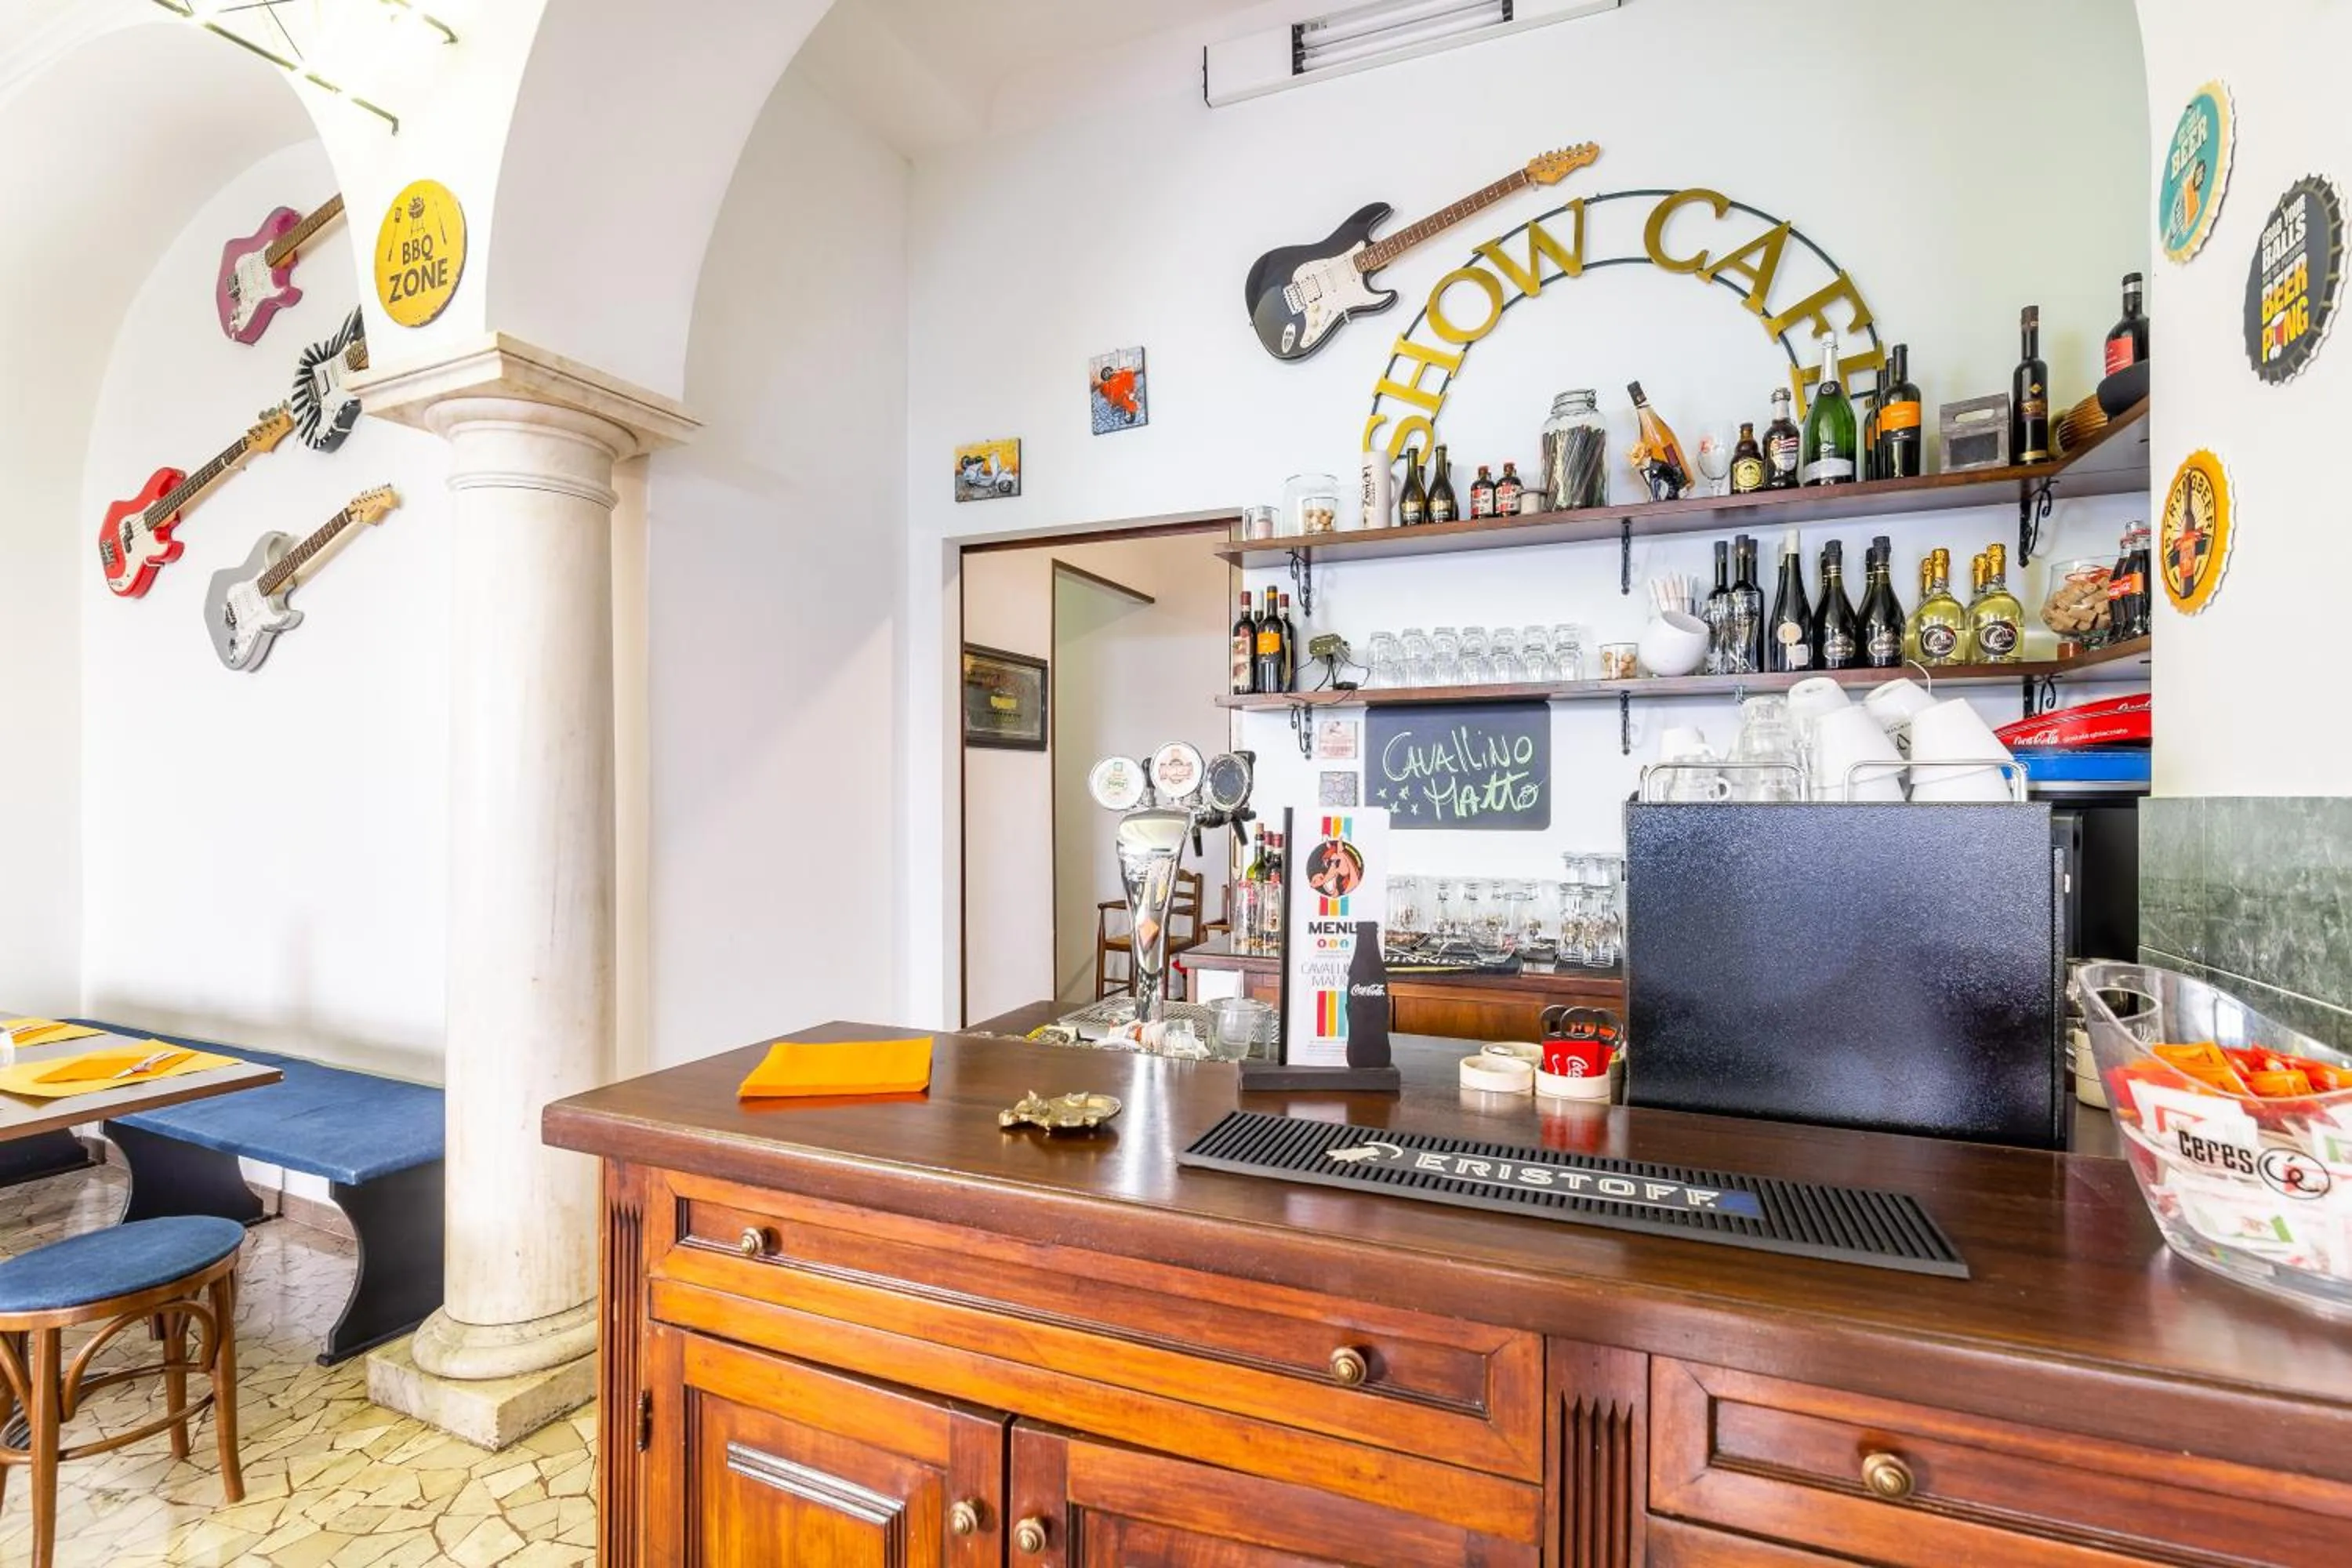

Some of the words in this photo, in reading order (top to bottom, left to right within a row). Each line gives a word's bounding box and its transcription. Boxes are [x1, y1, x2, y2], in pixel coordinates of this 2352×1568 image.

[2171, 114, 2208, 181] BEER
[401, 234, 434, 266] BBQ
[2262, 212, 2307, 274] BALLS
[388, 257, 448, 303] ZONE
[2262, 252, 2308, 326] BEER
[1363, 197, 1585, 466] SHOW
[2262, 295, 2309, 364] PNG
[2196, 476, 2213, 530] BEER
[1308, 921, 1359, 935] MENU
[1351, 983, 1385, 996] Coca-Cola
